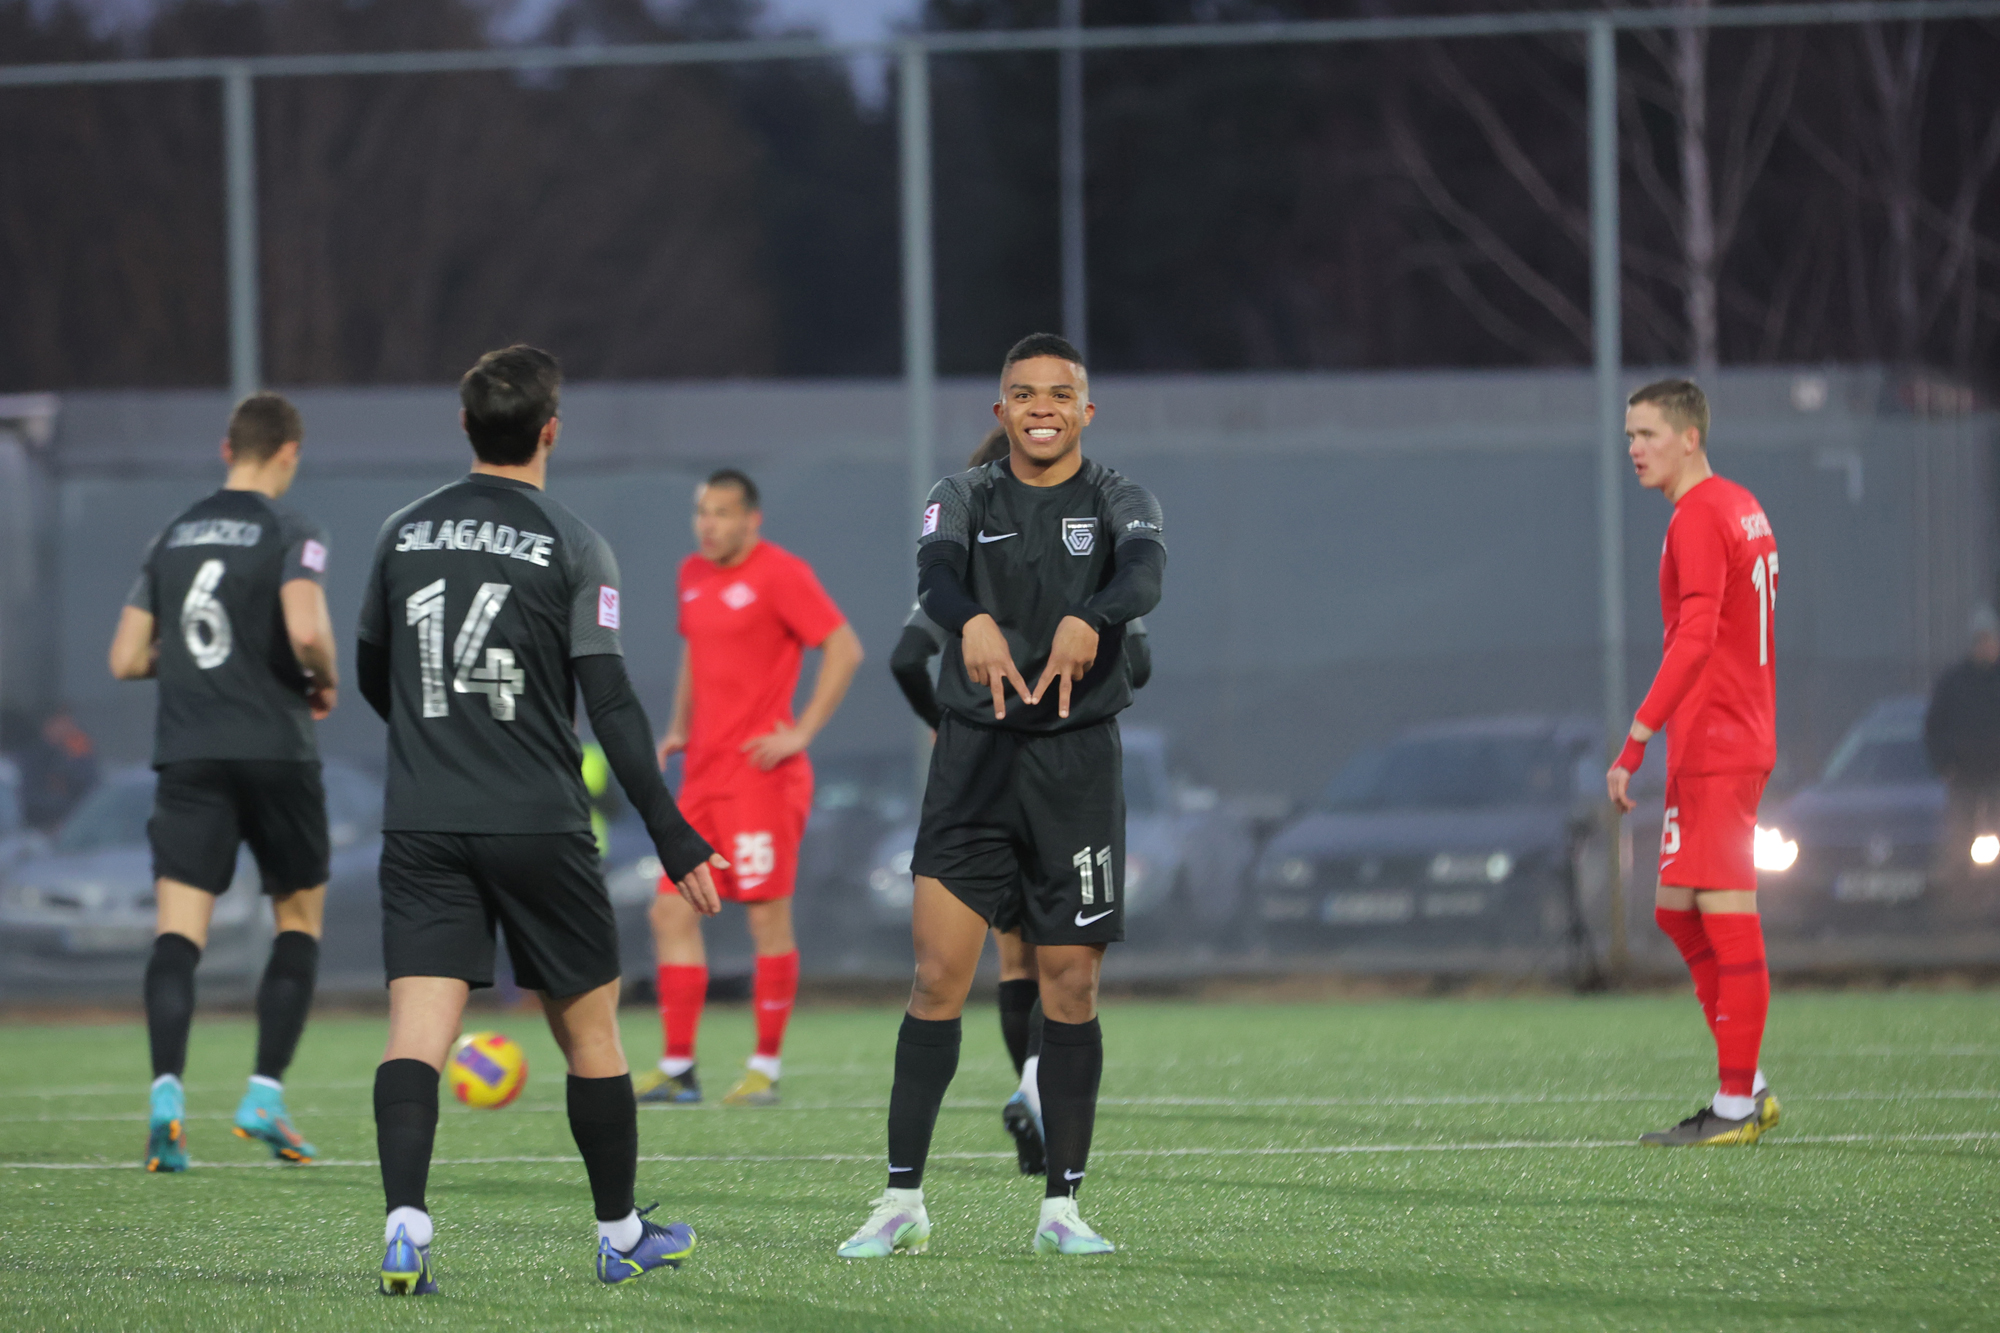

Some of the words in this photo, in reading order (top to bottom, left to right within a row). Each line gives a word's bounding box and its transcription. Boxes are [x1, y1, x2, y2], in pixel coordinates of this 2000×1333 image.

[396, 519, 555, 567] SILAGADZE
[182, 559, 232, 669] 6
[406, 578, 525, 721] 14
[734, 831, 776, 874] 26
[1073, 845, 1114, 905] 11
